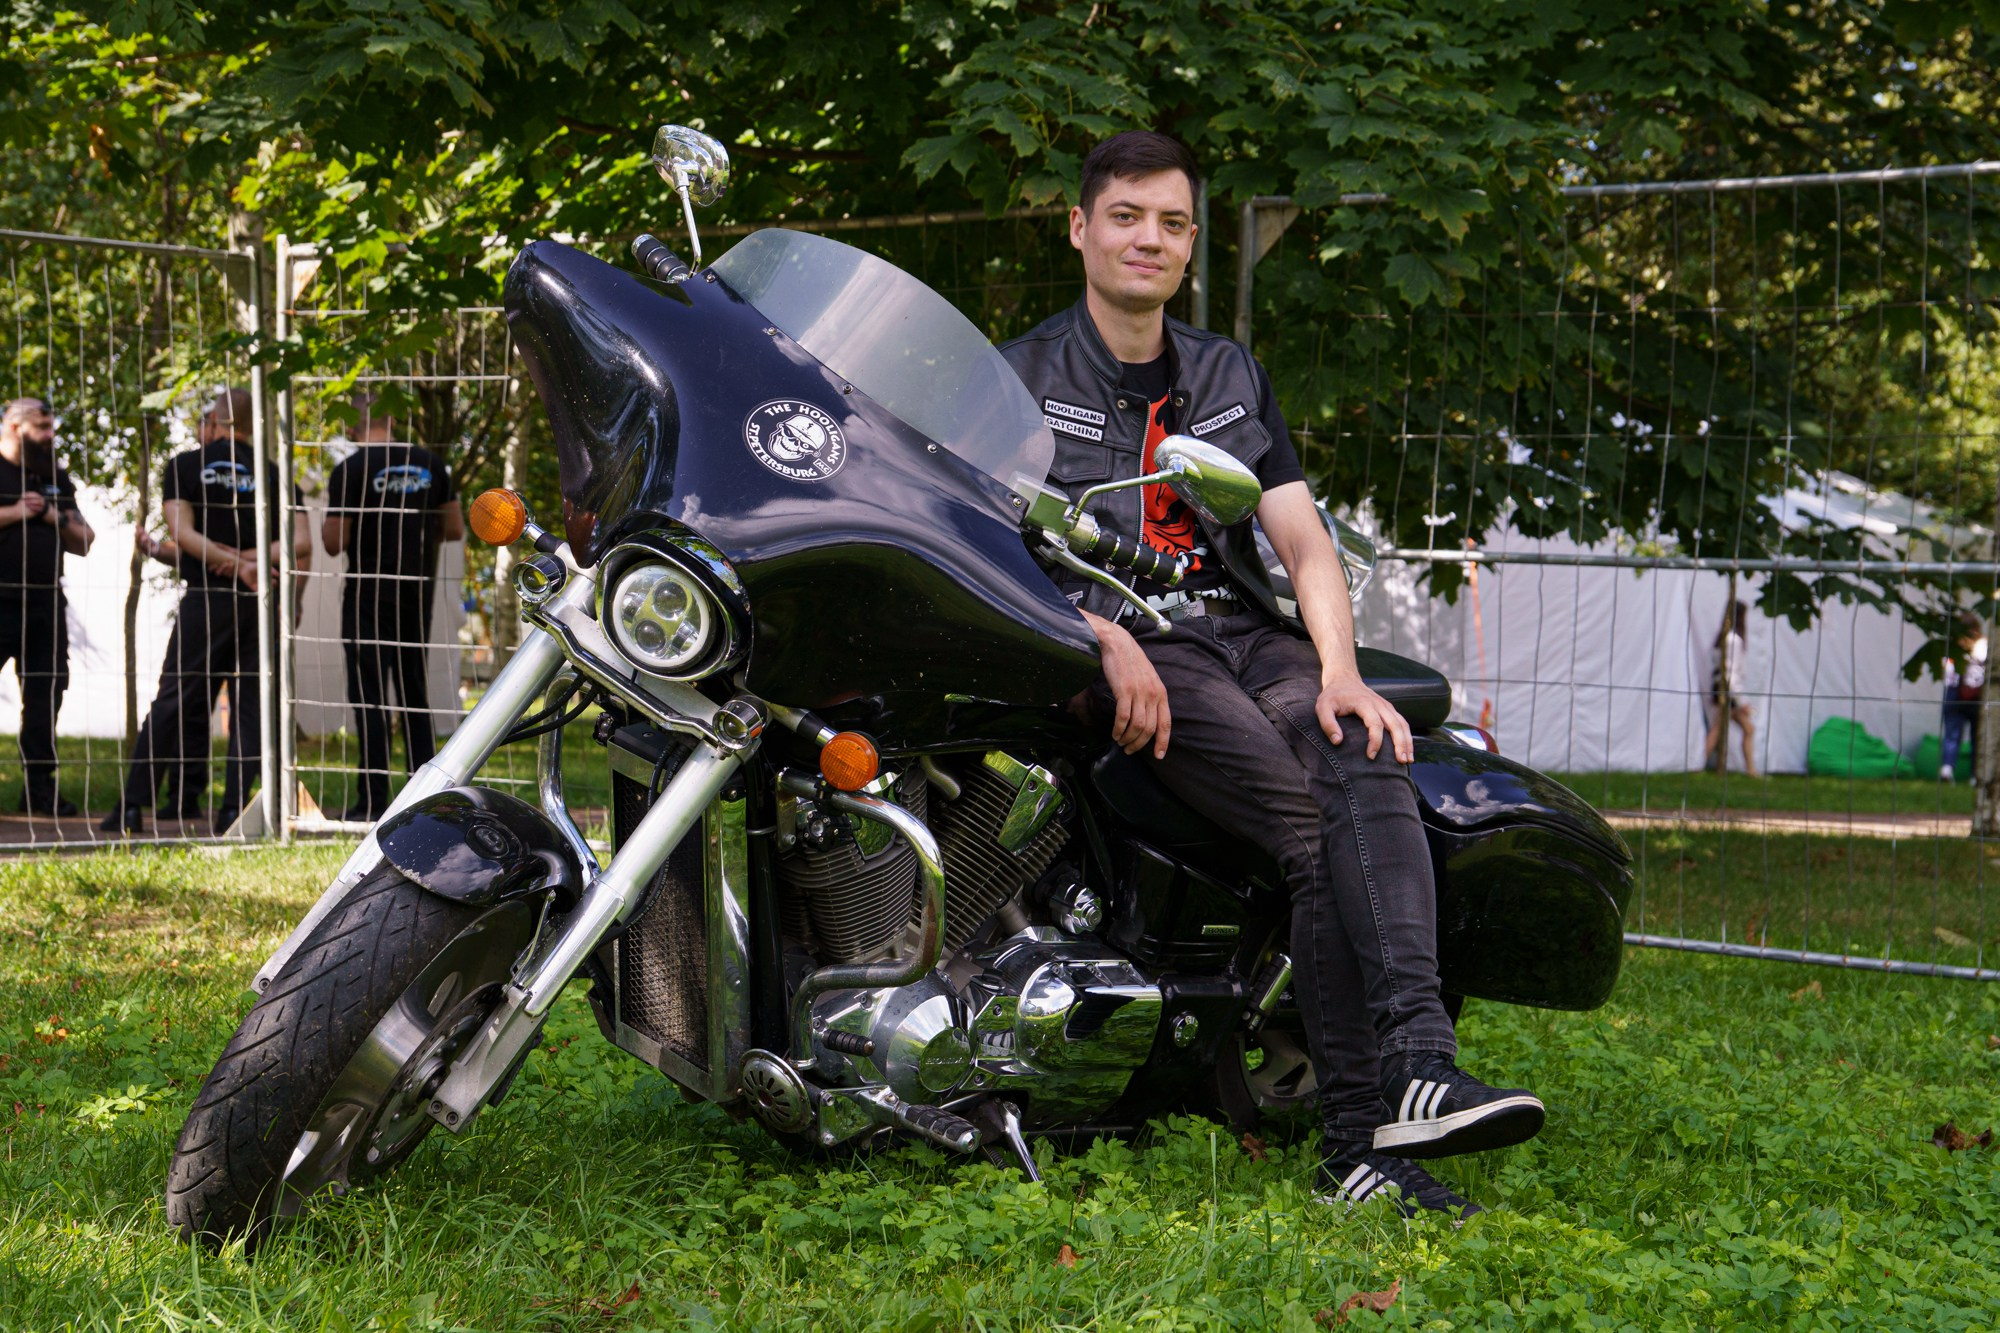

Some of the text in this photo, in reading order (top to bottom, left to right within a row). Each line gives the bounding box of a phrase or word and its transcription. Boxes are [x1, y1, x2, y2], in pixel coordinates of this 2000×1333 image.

[1046, 402, 1104, 423] HOOLIGANS
[1194, 407, 1242, 434] PROSPECT
[764, 403, 842, 465] THE HOOLIGANS
[1046, 417, 1101, 439] GATCHINA
